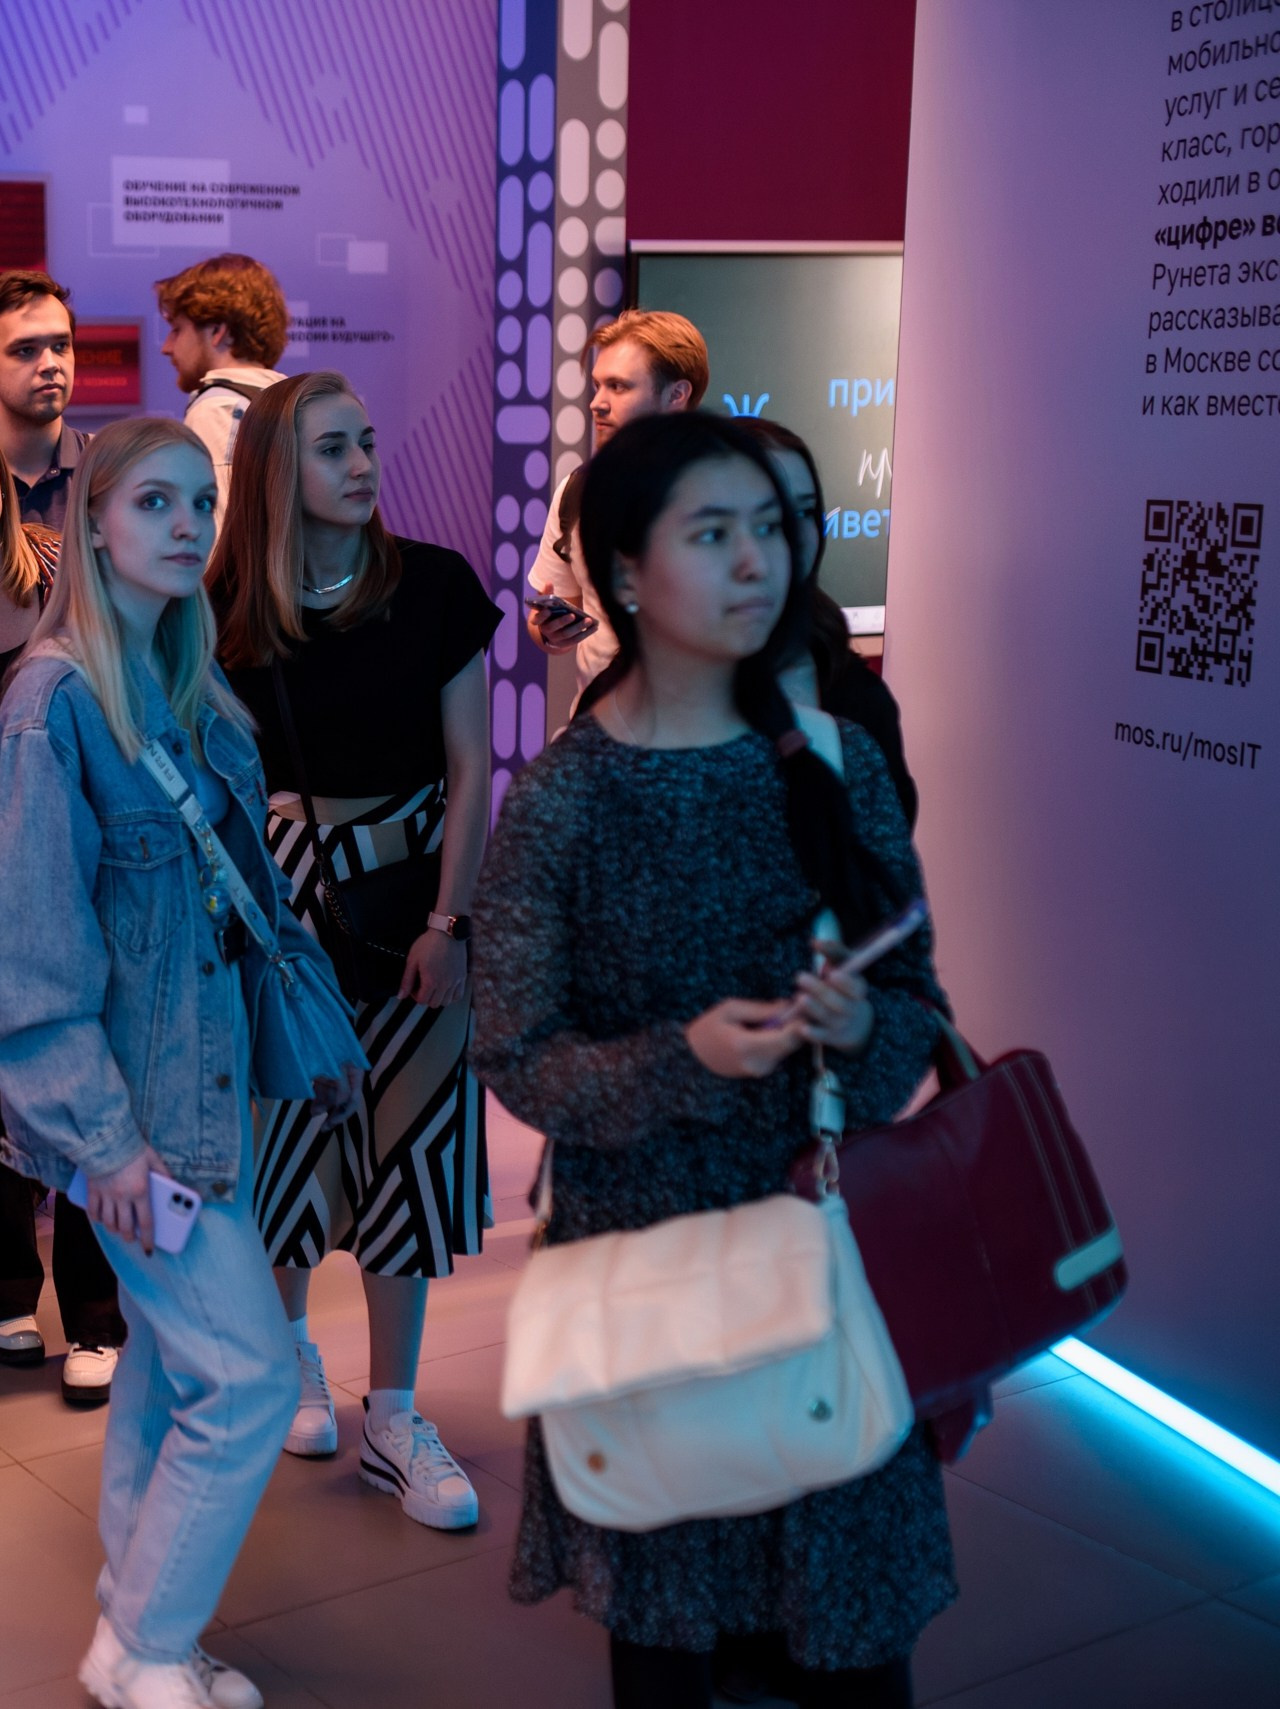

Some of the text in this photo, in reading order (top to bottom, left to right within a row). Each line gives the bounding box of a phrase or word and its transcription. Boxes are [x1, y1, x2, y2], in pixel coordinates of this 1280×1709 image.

[1171, 10, 1183, 32] в
[1165, 87, 1228, 127] услуг
[1234, 83, 1247, 106] и
[1161, 122, 1280, 163] класс, гор
[124, 180, 301, 196] ОБУЧЕНИЕ НА СОВРЕМЕННОМ
[1158, 174, 1240, 206] ходили
[1248, 171, 1260, 193] в
[1154, 216, 1256, 250] «цифре»
[1152, 262, 1231, 296] Рунета
[1148, 304, 1280, 339] рассказыва
[1146, 354, 1157, 373] в
[1164, 347, 1251, 373] Москве
[829, 378, 894, 417] при
[1142, 396, 1154, 415] и
[1161, 395, 1200, 416] как
[1115, 722, 1261, 769] mos.ru/mosIT
